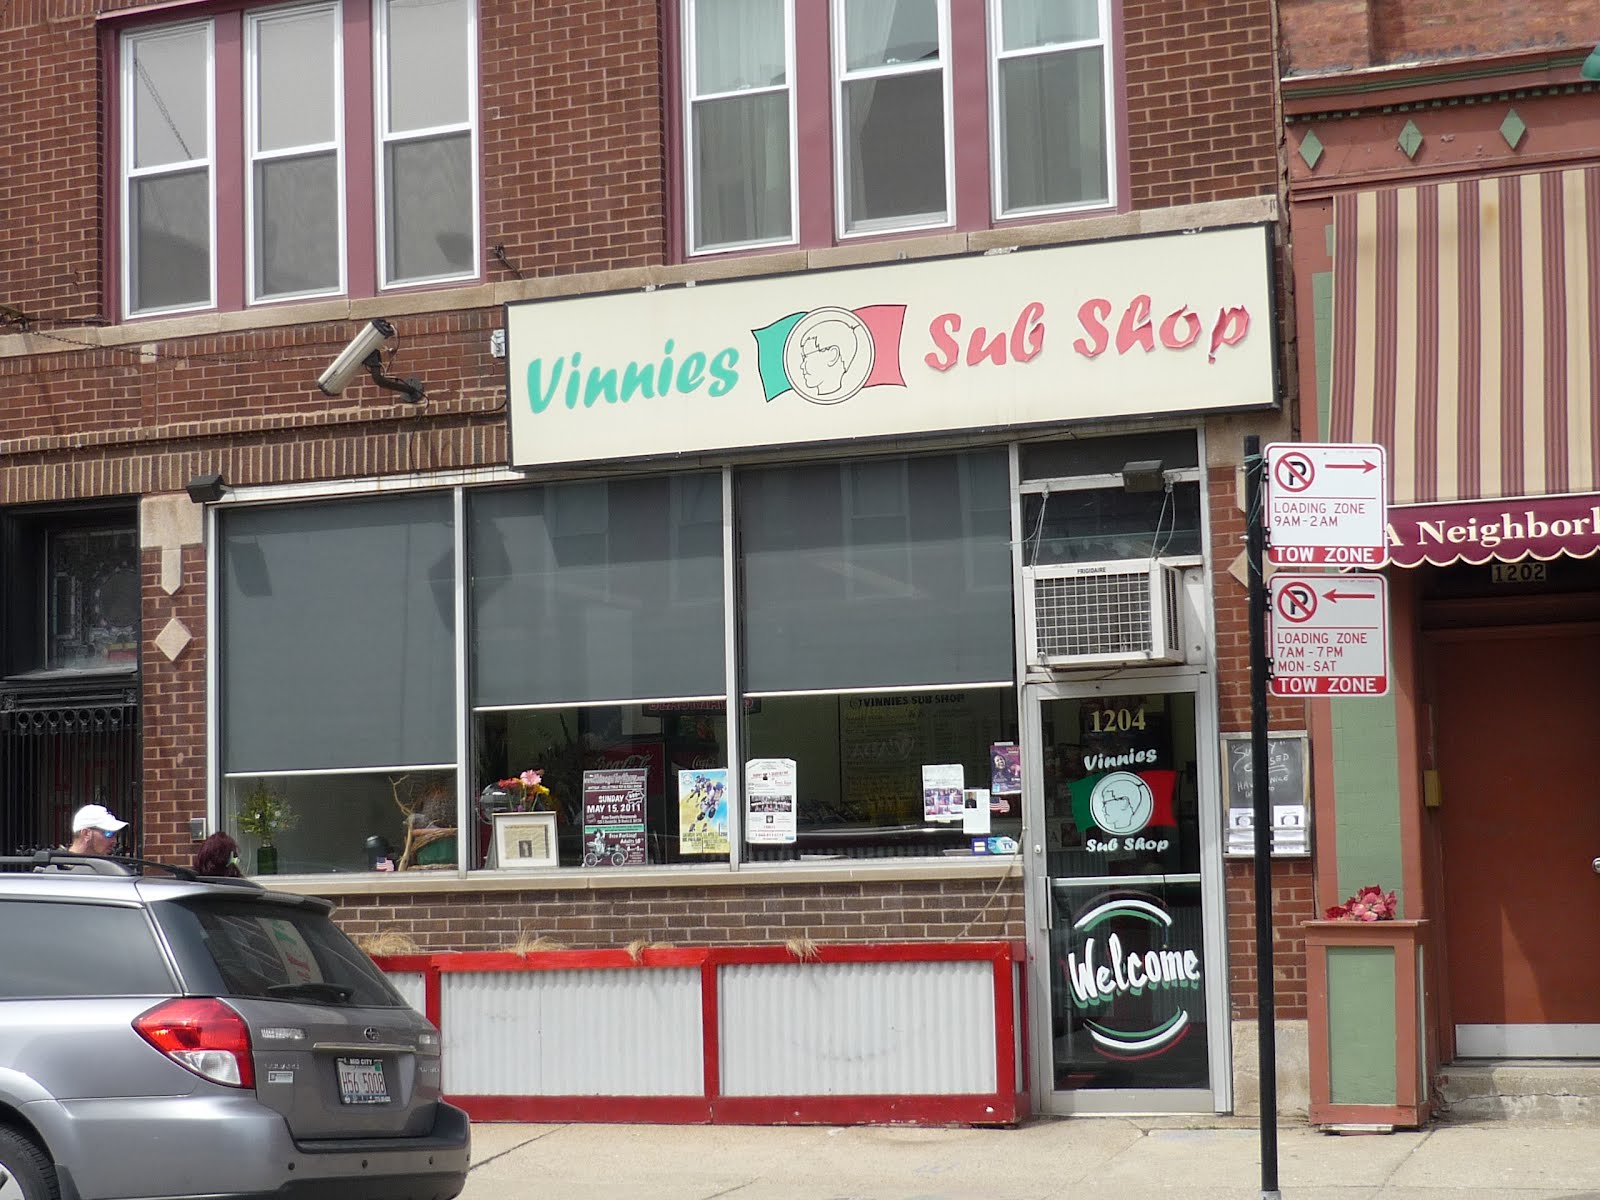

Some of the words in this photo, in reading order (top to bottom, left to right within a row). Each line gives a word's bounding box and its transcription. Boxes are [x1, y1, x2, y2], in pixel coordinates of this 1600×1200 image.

[526, 338, 739, 414] Vinnies
[924, 301, 1046, 372] Sub
[1073, 294, 1250, 365] Shop
[1274, 502, 1327, 514] LOADING
[1334, 503, 1365, 514] ZONE
[1386, 522, 1404, 547] A
[1274, 547, 1315, 562] TOW
[1324, 547, 1374, 563] ZONE
[1076, 566, 1107, 575] FRIGIDAIRE
[1494, 563, 1545, 582] 1202
[1277, 632, 1329, 644] LOADING
[1336, 632, 1368, 644] ZONE
[1278, 677, 1317, 693] TOW
[1327, 677, 1377, 693] ZONE
[863, 696, 908, 708] VINNIES
[911, 695, 932, 705] SUB
[935, 693, 965, 703] SHOP
[1091, 707, 1146, 733] 1204
[1083, 747, 1157, 771] Vinnies
[598, 794, 625, 803] SUNDAY
[586, 804, 606, 813] MAY
[620, 803, 641, 812] 2011
[1086, 838, 1119, 852] Sub
[1124, 837, 1170, 852] Shop
[1066, 932, 1201, 1002] Welcome
[342, 1071, 360, 1094] H56
[362, 1072, 386, 1094] 5008
